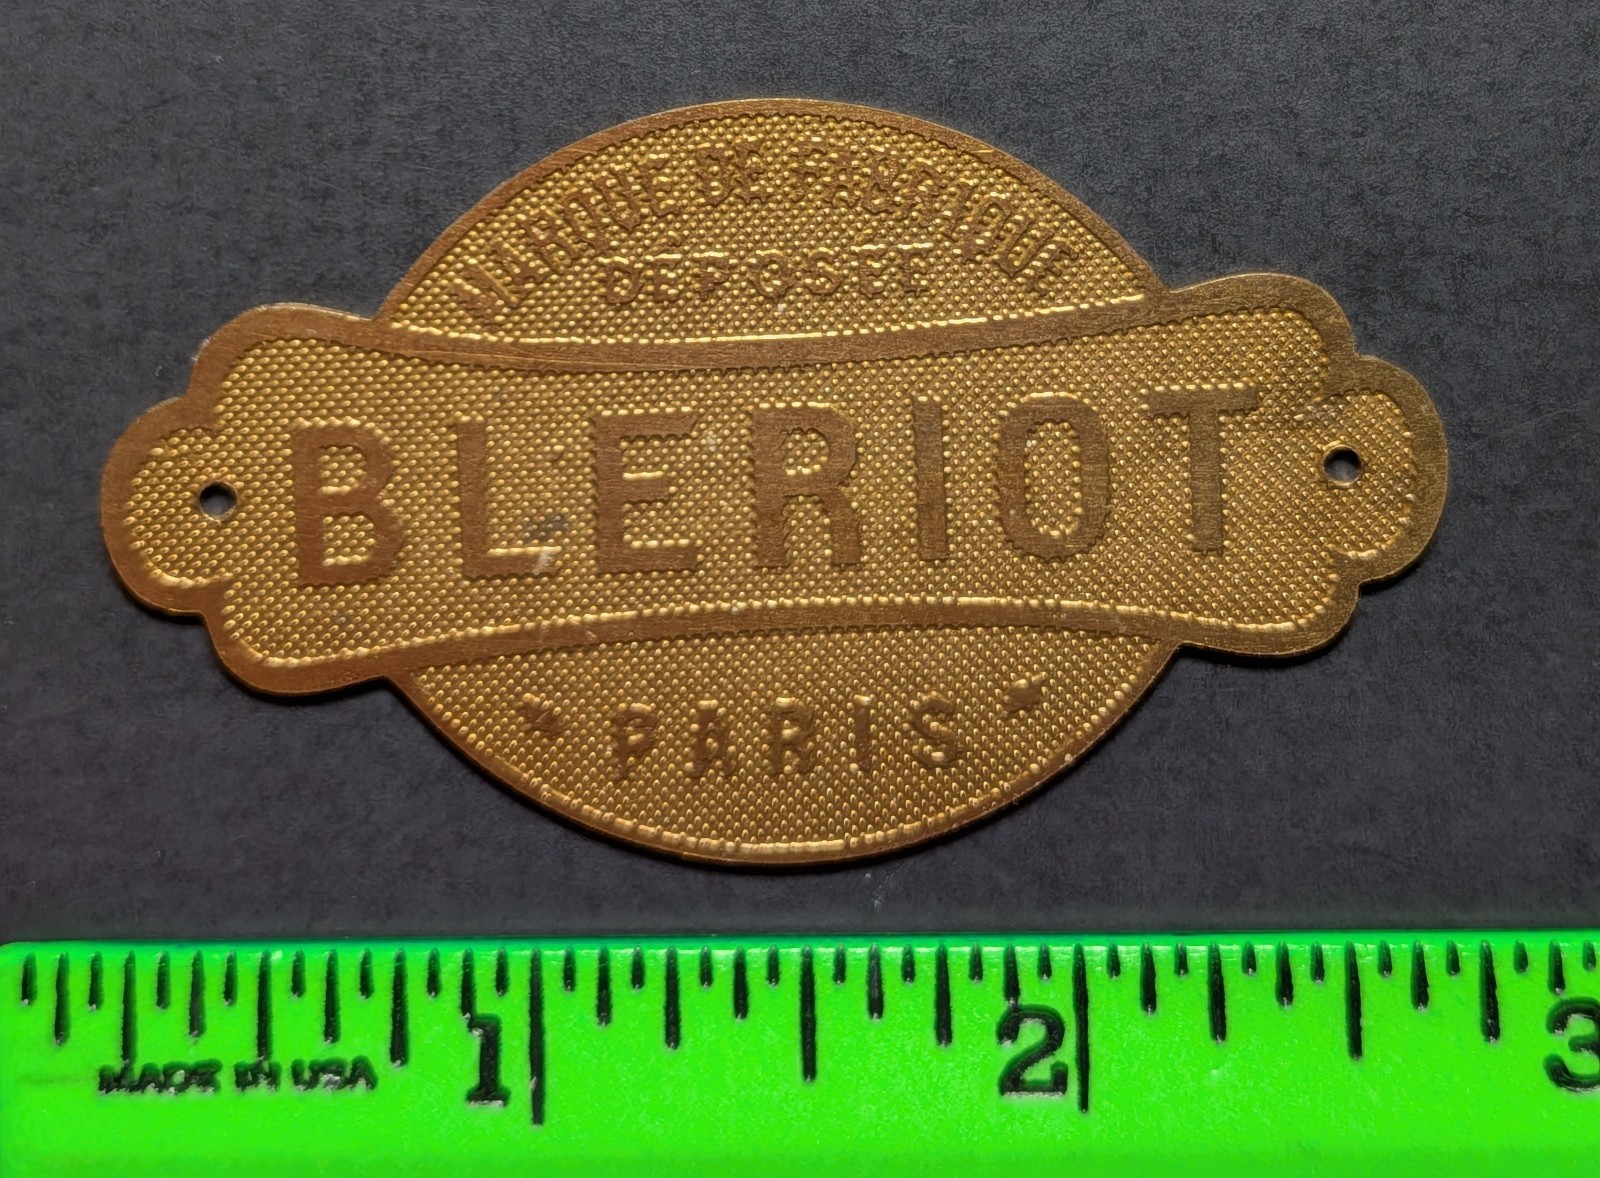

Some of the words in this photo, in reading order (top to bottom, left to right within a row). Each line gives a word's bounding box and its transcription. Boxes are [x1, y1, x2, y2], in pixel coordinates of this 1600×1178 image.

[697, 141, 770, 206] DE
[290, 383, 1258, 588] BLERIOT
[611, 694, 963, 778] PARIS
[98, 1059, 222, 1094] MADE
[234, 1059, 281, 1092] IN
[291, 1056, 379, 1091] USA
[466, 1013, 509, 1107] 1
[997, 1003, 1068, 1097] 2
[1544, 997, 1600, 1092] 3
